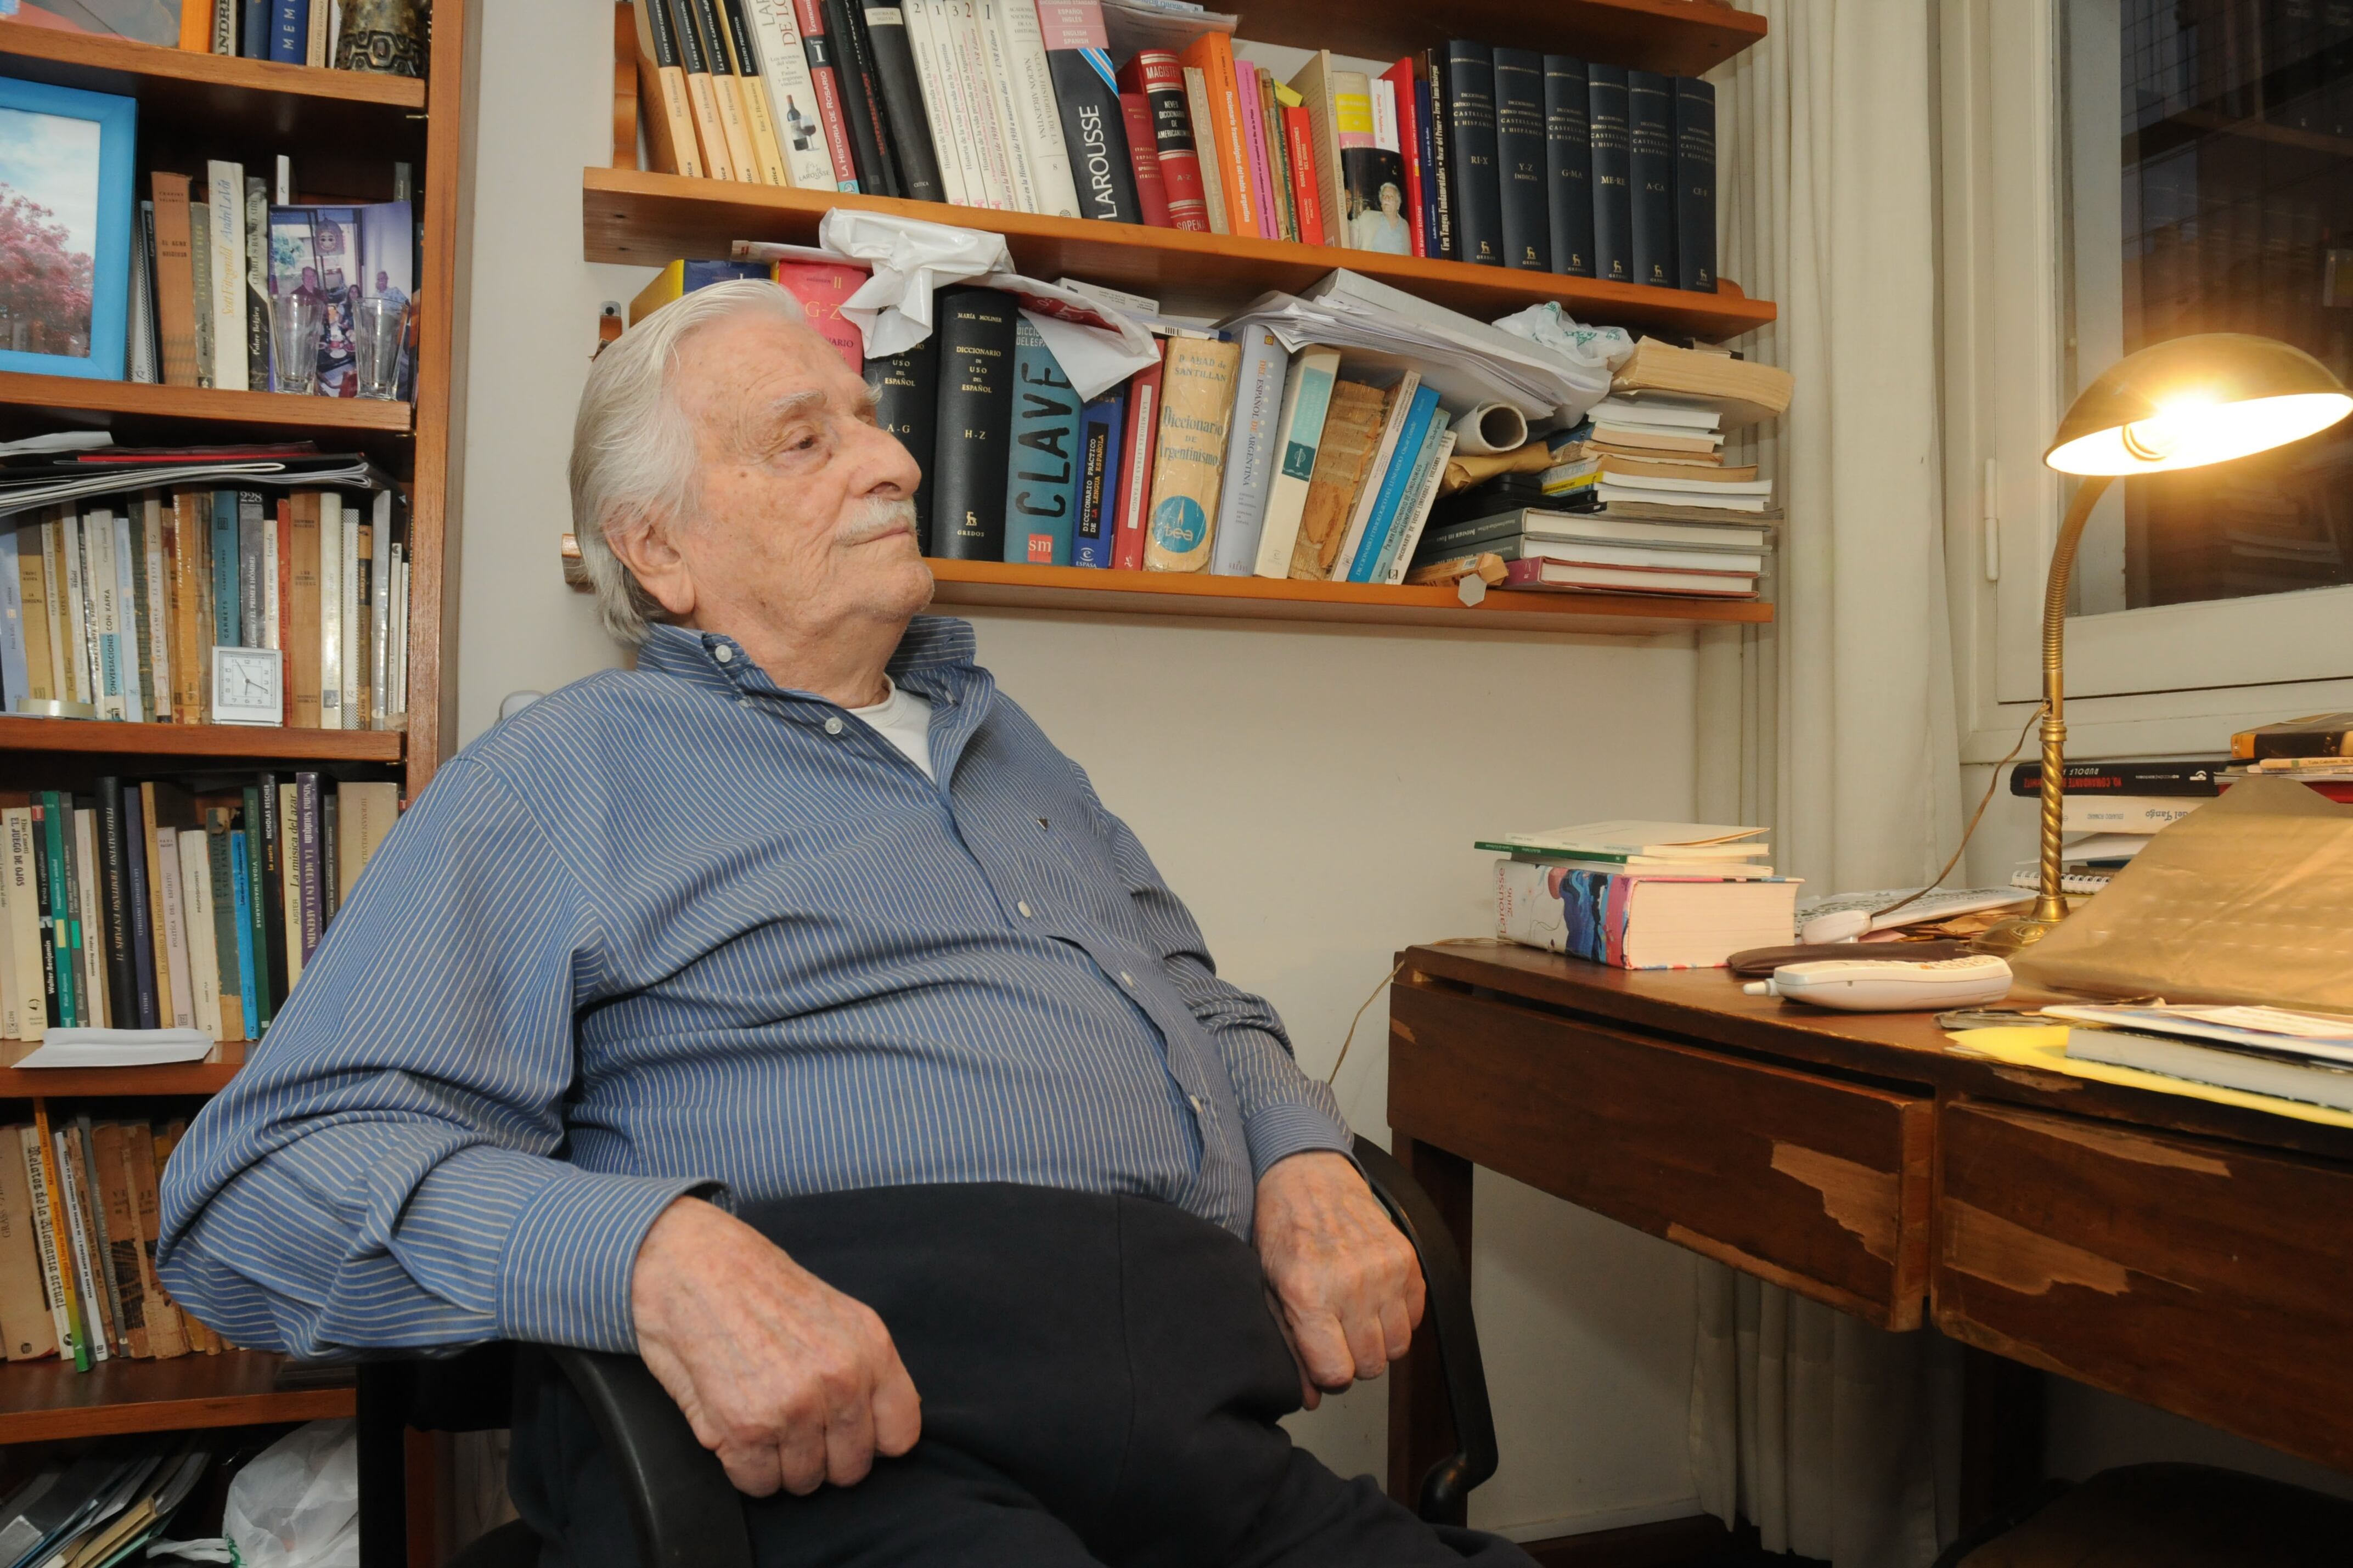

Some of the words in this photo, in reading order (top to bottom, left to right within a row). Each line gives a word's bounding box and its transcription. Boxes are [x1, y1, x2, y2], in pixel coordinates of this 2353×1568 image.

[914, 3, 921, 13] 2
[936, 5, 941, 15] 1
[953, 5, 959, 16] 3
[965, 2, 971, 18] 2
[985, 4, 990, 19] 1
[780, 22, 797, 46] DE
[813, 44, 826, 63] 1
[820, 71, 834, 109] ROSARIO
[830, 110, 837, 122] DE
[833, 125, 846, 163] HISTORIA
[1078, 105, 1118, 219] LAROUSSE
[1225, 91, 1235, 126] Diccionario
[1240, 193, 1251, 223] argentina
[1437, 146, 1445, 161] Oscar
[842, 165, 849, 177] LA
[1601, 176, 1626, 186] ME-RE
[1436, 168, 1449, 213] Fundamentales
[1438, 213, 1450, 235] Tangos
[979, 314, 1002, 323] MOLINER
[956, 346, 1001, 357] DICCIONARIO
[892, 359, 910, 368] USO
[1217, 360, 1226, 369] de
[1258, 359, 1267, 375] DEL
[885, 376, 916, 386] ESPAÑOL
[961, 384, 993, 393] ESPAÑOL
[1251, 379, 1264, 419] ESPAÑOL
[1163, 405, 1223, 437] Diccionario
[1250, 421, 1258, 432] DE
[1185, 435, 1197, 443] DE
[1087, 438, 1096, 476] PRÁCTICO
[1095, 435, 1105, 472] ESPAÑOLA
[1242, 433, 1256, 487] ARGENTINA
[240, 491, 262, 503] 228
[1093, 476, 1101, 505] LENGUA
[1083, 480, 1093, 532] DICCIONARIO
[1091, 508, 1097, 518] LA
[1090, 522, 1096, 533] DE
[1164, 524, 1194, 542] tea
[1028, 538, 1052, 553] sm
[220, 600, 228, 639] CARNETS
[106, 634, 117, 696] CONVERSACIONES
[289, 793, 298, 816] azar
[303, 783, 312, 809] Susana
[10, 817, 20, 828] EL
[2112, 809, 2138, 821] Tango
[287, 818, 298, 834] del
[301, 811, 313, 844] Saulquin
[12, 828, 21, 853] JUEGO
[14, 855, 22, 865] DE
[288, 837, 299, 872] música
[304, 849, 313, 859] LA
[15, 867, 25, 887] OJOS
[305, 861, 314, 883] MODA
[290, 875, 299, 888] La
[305, 885, 314, 895] EN
[109, 870, 121, 911] ERMITAÑO
[306, 896, 315, 907] LA
[1498, 867, 1507, 934] Larousse
[112, 913, 121, 925] EN
[114, 926, 123, 949] PARÍS
[306, 909, 317, 949] ARGENTINA
[44, 940, 54, 971] Benjamin
[47, 972, 55, 995] Walter
